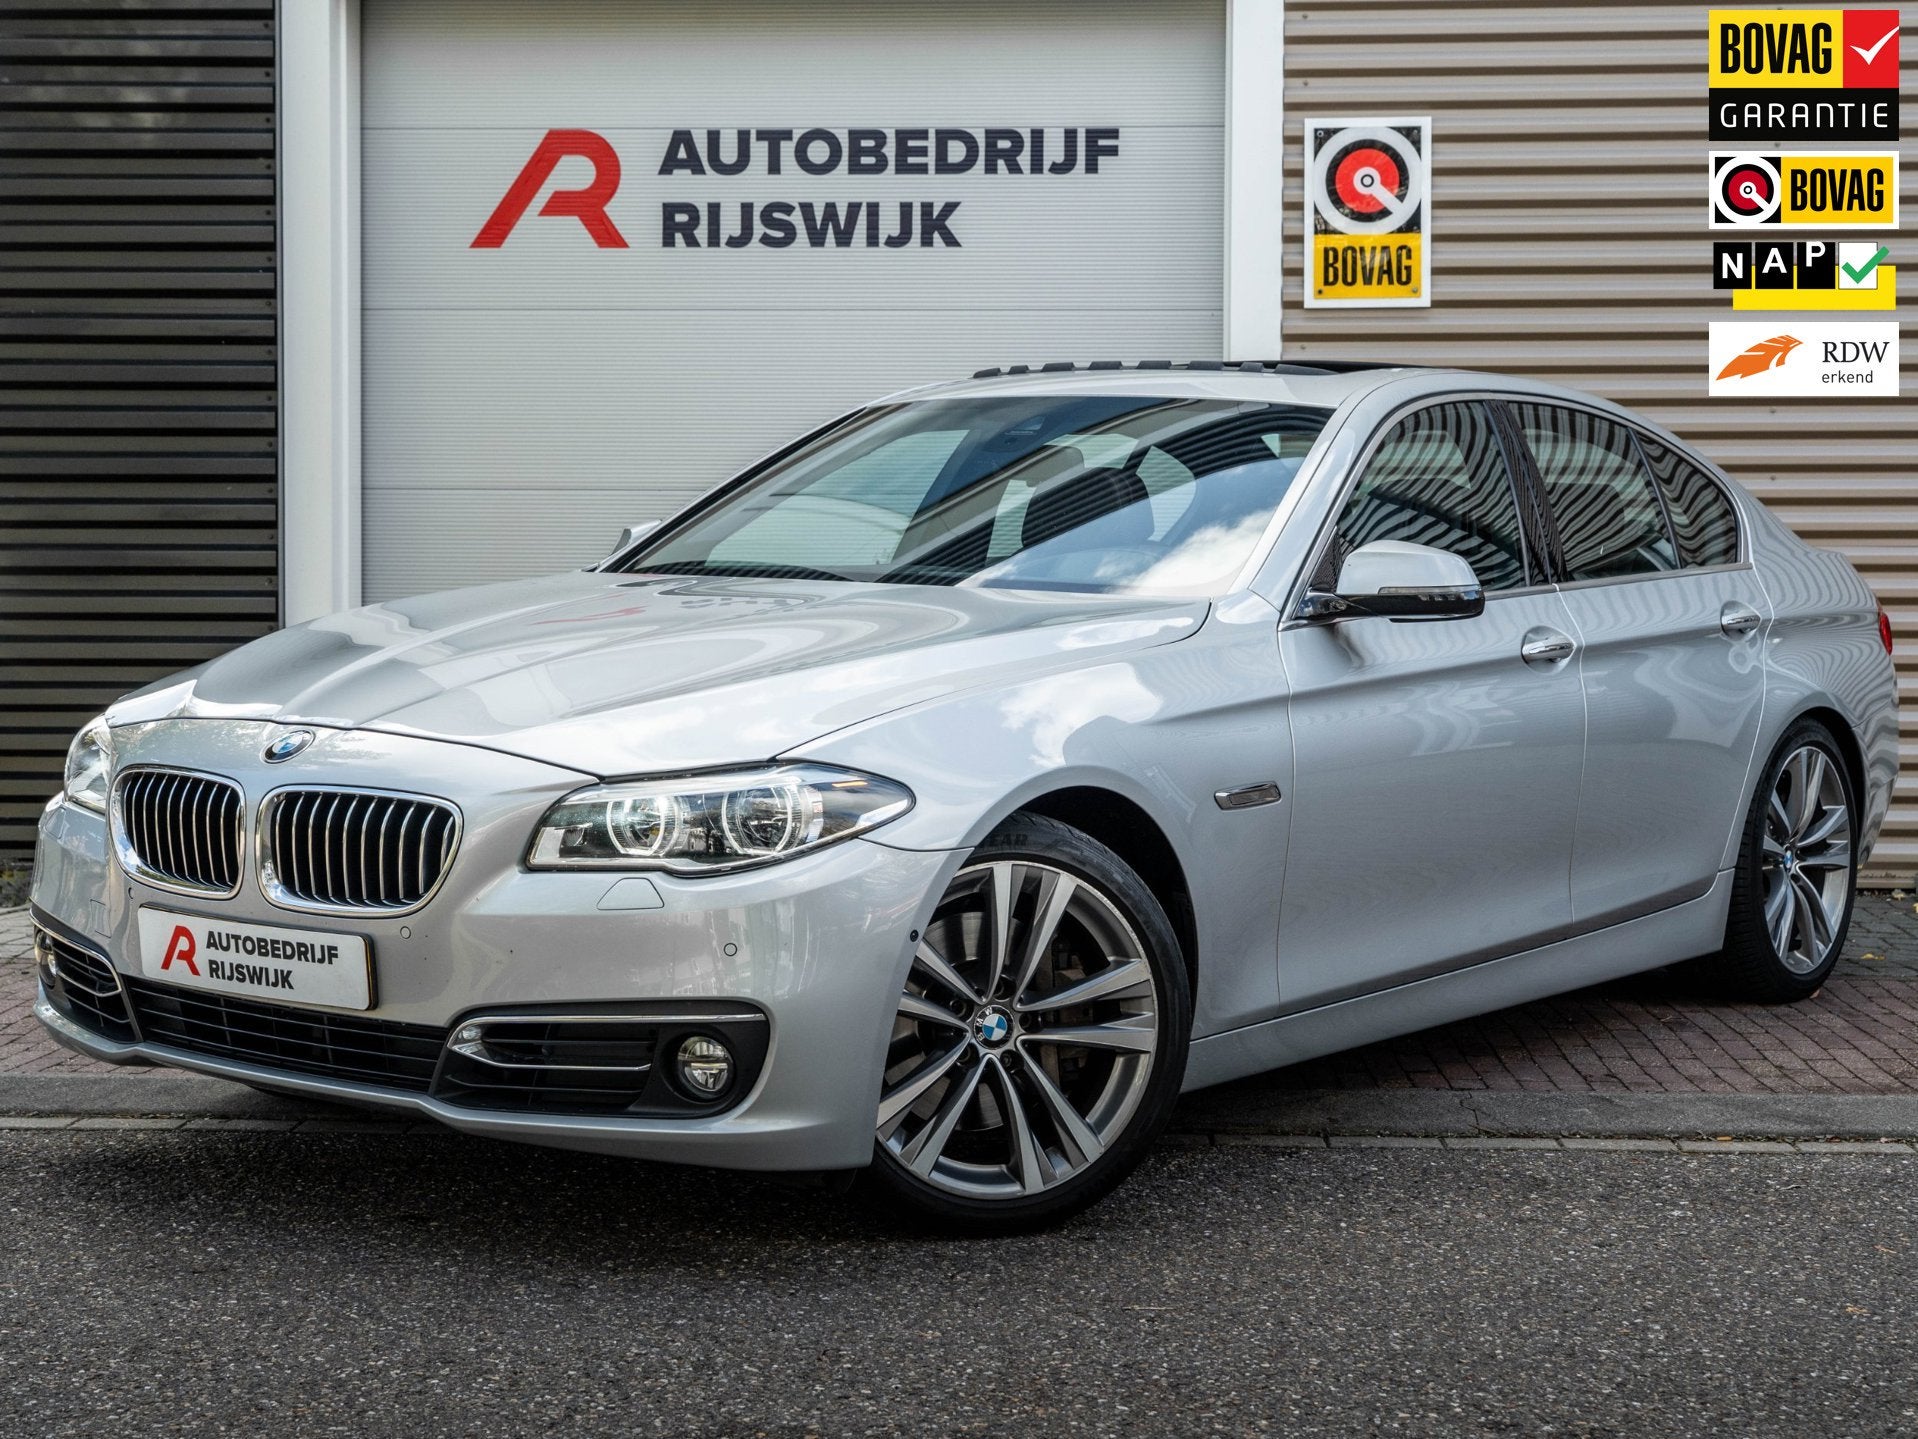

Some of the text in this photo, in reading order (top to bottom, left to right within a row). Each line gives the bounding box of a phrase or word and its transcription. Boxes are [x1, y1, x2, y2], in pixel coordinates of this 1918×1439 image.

[657, 127, 1120, 176] AUTOBEDRIJF
[661, 201, 963, 249] RIJSWIJK
[1323, 244, 1412, 287] BOVAG
[205, 930, 340, 965] AUTOBEDRIJF
[208, 959, 295, 990] RIJSWIJK
